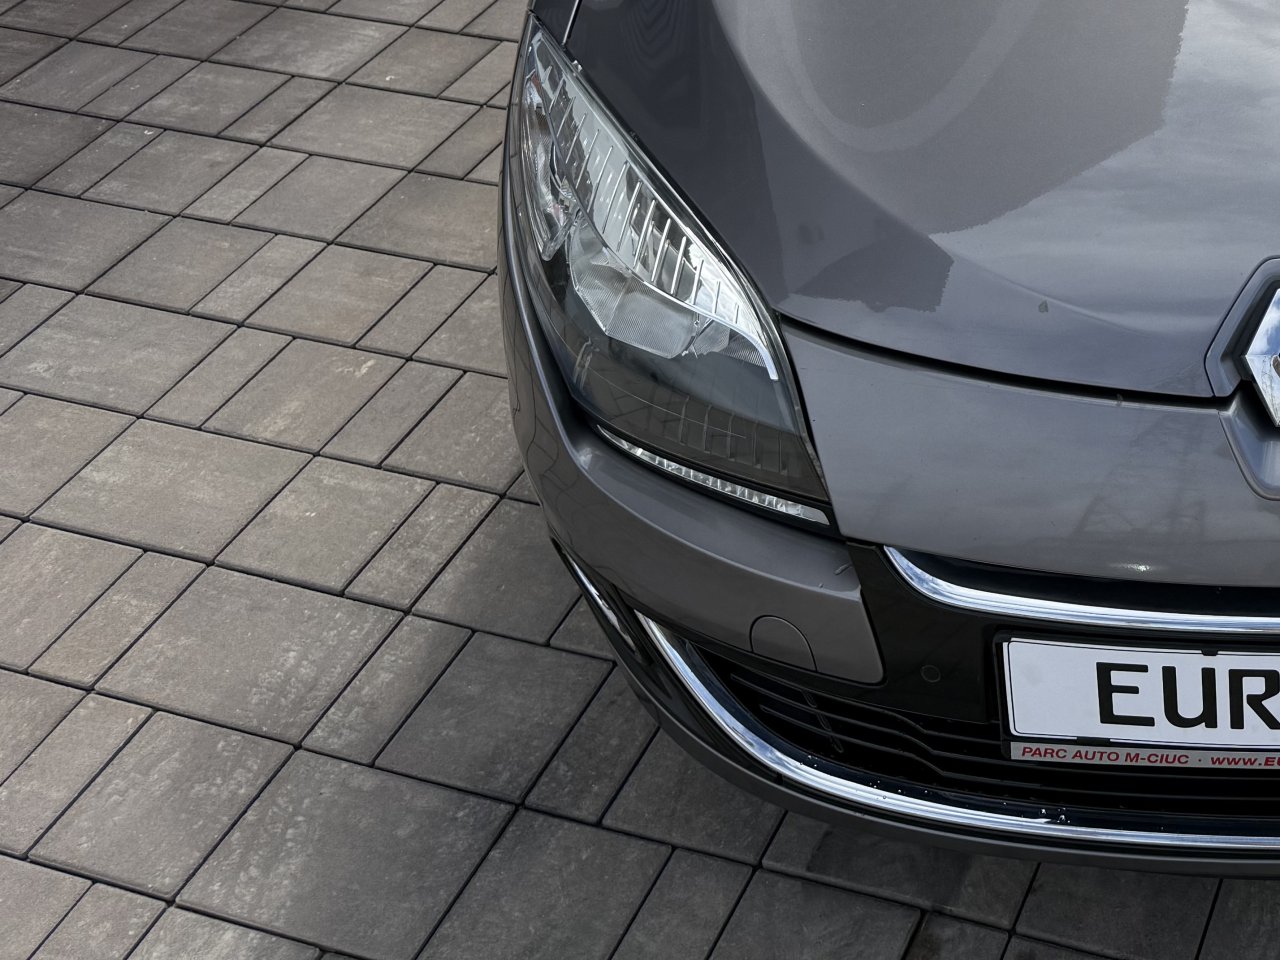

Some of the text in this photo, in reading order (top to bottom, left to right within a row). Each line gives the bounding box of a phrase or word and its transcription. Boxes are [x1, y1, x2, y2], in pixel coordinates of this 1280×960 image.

[1021, 746, 1067, 759] PARC
[1071, 749, 1120, 762] AUTO
[1124, 752, 1190, 765] M-CIUC
